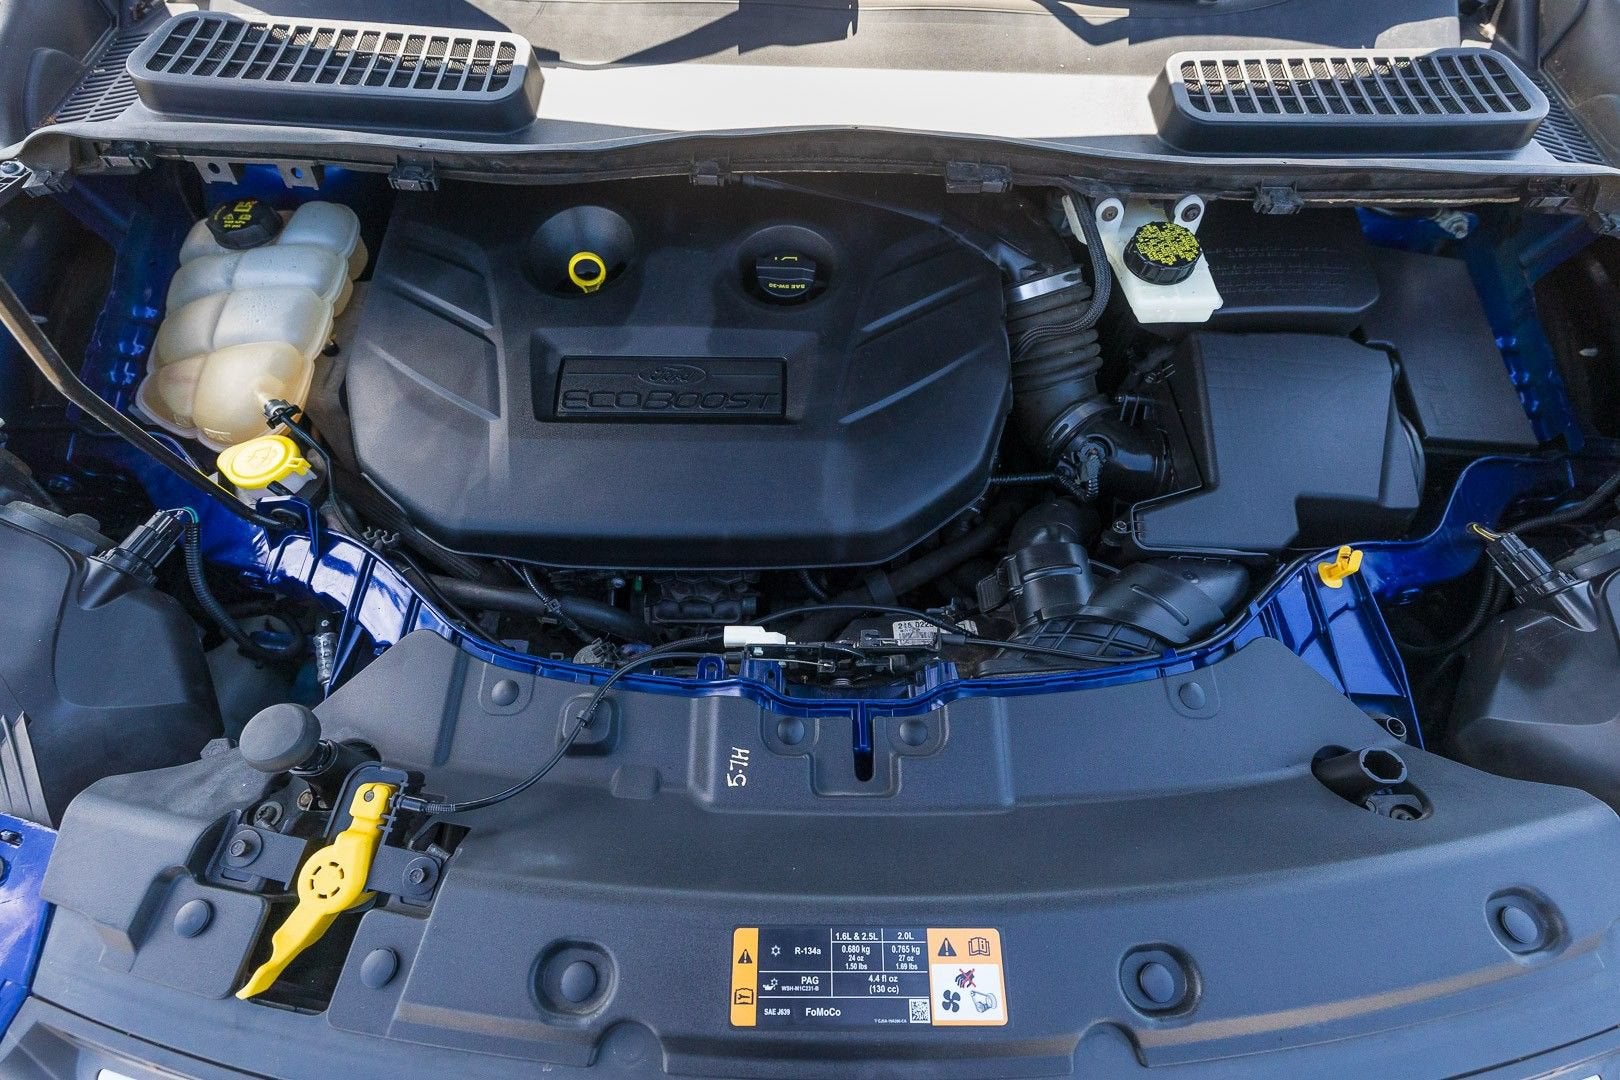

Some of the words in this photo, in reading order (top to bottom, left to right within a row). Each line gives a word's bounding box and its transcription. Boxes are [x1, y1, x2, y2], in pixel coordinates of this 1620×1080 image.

[835, 932, 852, 941] 1.6L
[853, 932, 860, 941] &
[861, 932, 879, 941] 2.5L
[897, 932, 915, 940] 2.0L
[794, 947, 822, 955] R-134a
[841, 945, 860, 954] 0.680
[861, 945, 871, 956] kg
[891, 945, 910, 954] 0.765
[911, 945, 921, 956] kg
[898, 954, 906, 962] 27
[801, 976, 820, 985] PAG
[868, 974, 880, 983] 4.4
[869, 985, 886, 995] (130
[886, 985, 900, 995] cc)
[763, 1008, 777, 1016] SAE
[805, 1007, 841, 1017] FoMoCo
